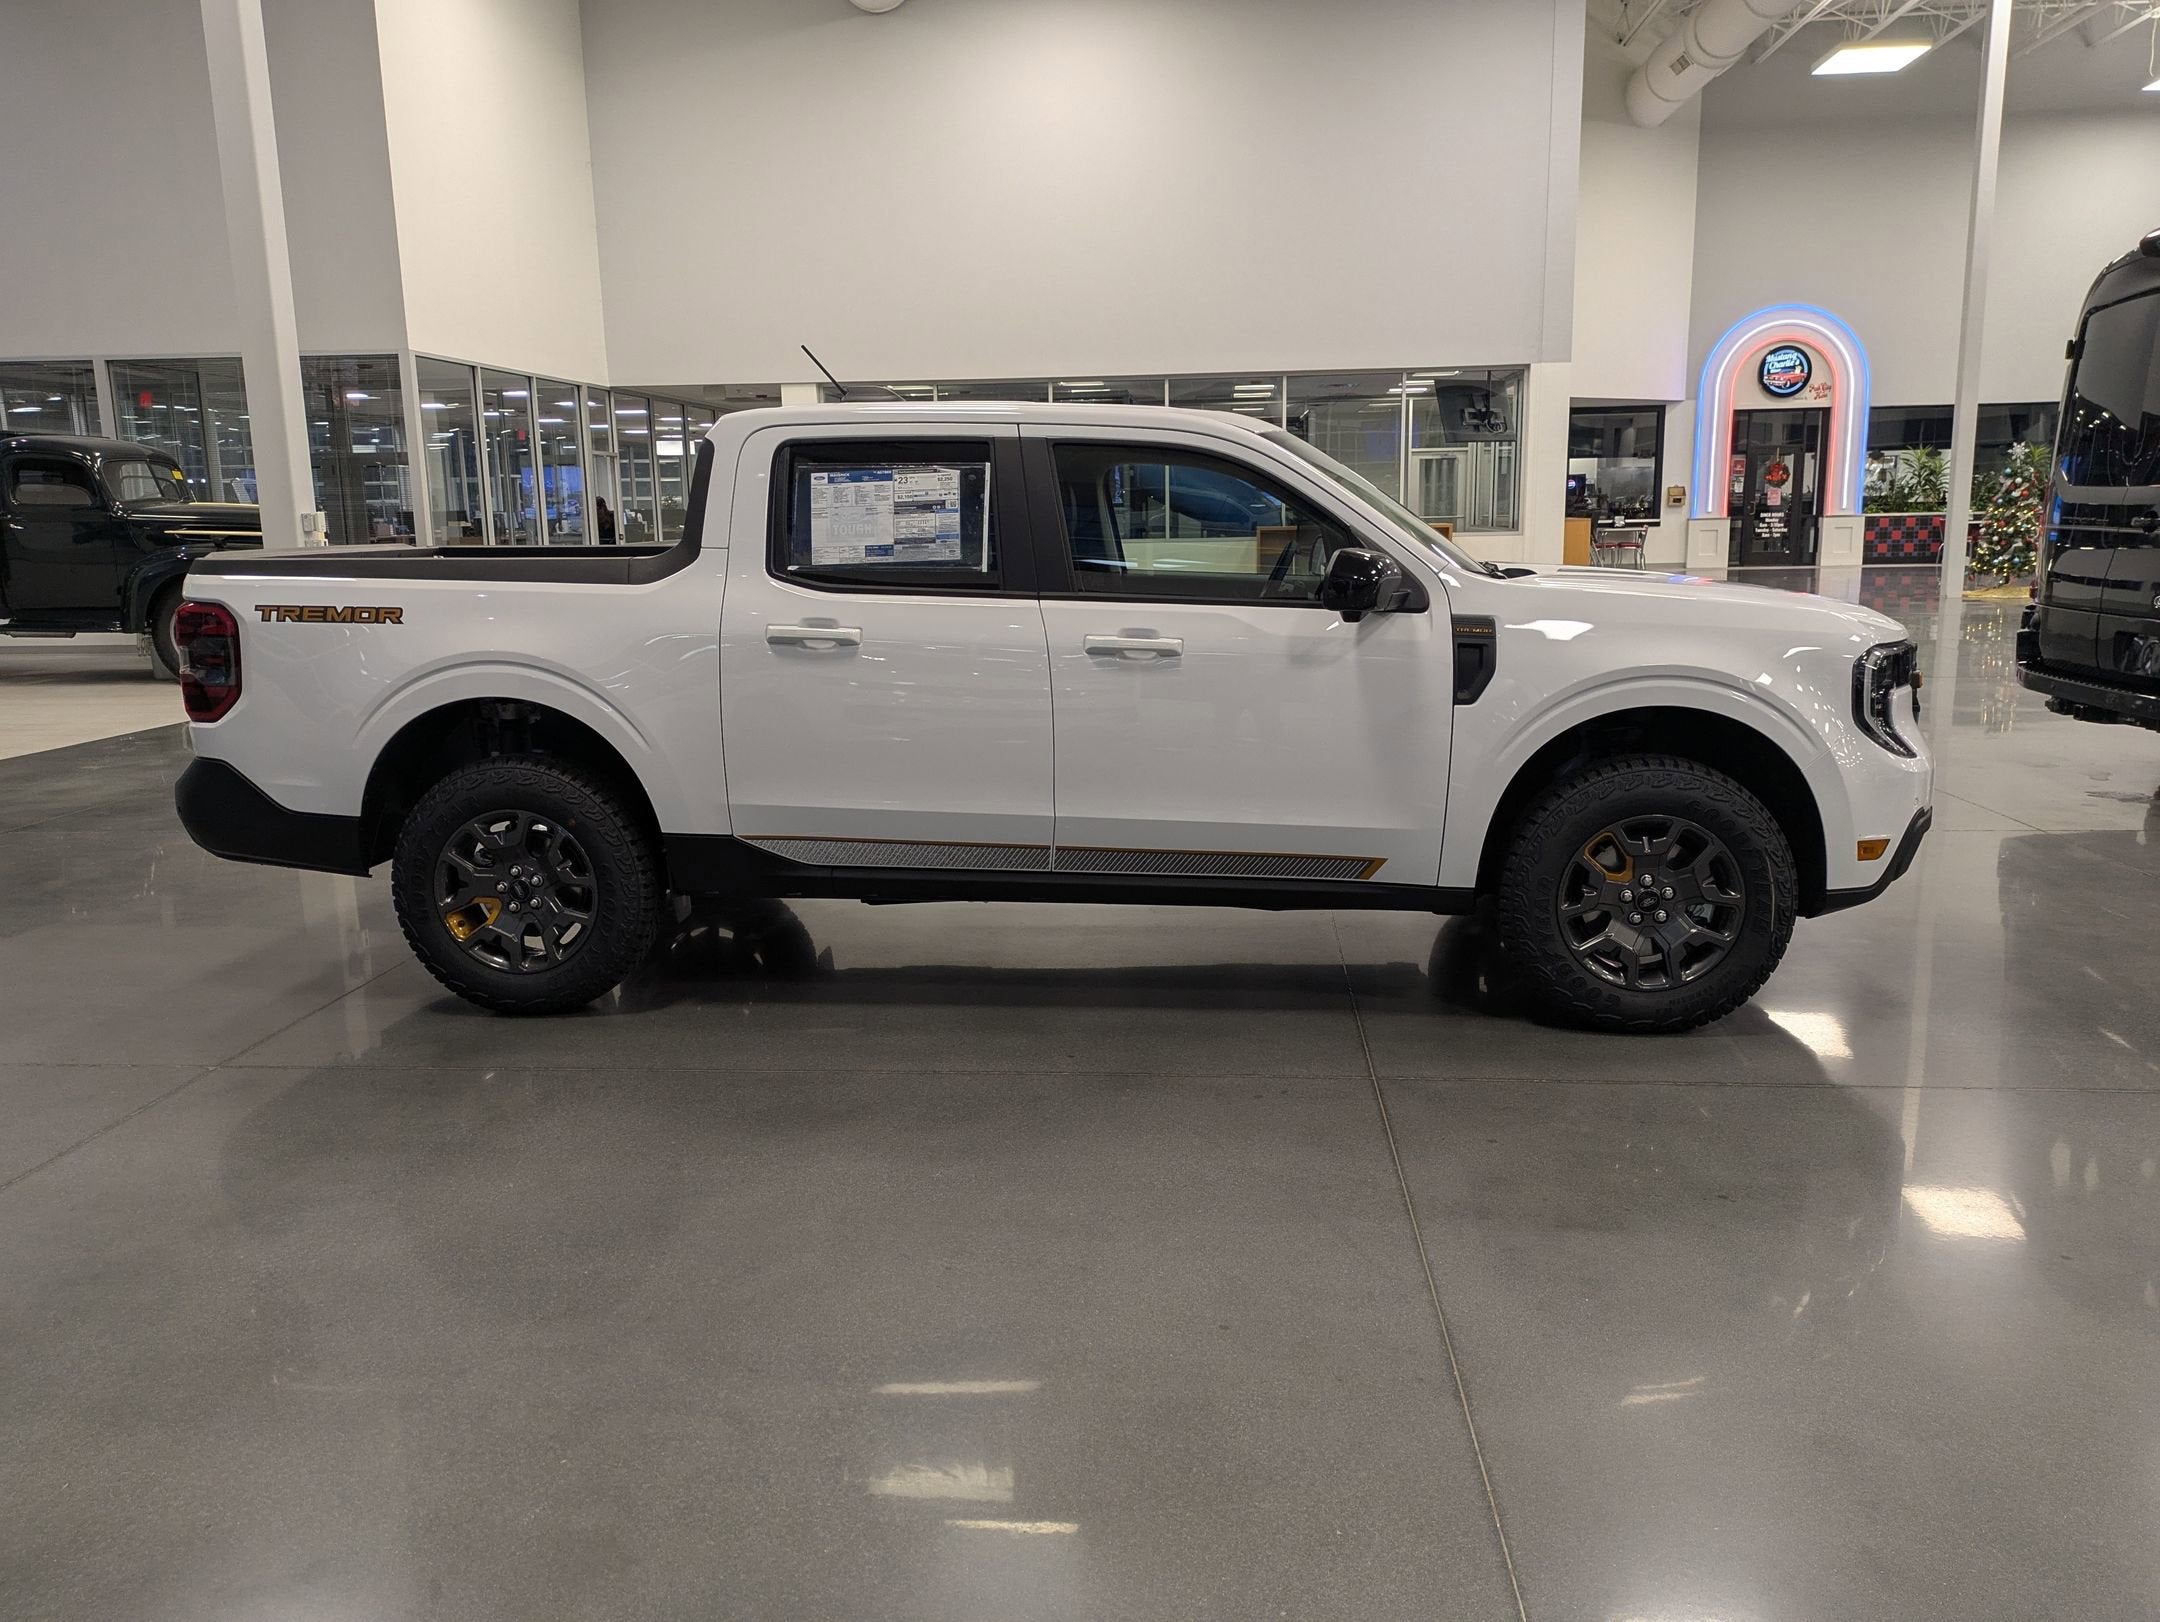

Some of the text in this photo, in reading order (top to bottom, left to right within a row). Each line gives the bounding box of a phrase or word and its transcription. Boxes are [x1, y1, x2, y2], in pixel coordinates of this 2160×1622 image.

[898, 476, 909, 485] 23
[832, 524, 872, 536] TOUGH
[254, 604, 404, 625] TREMOR
